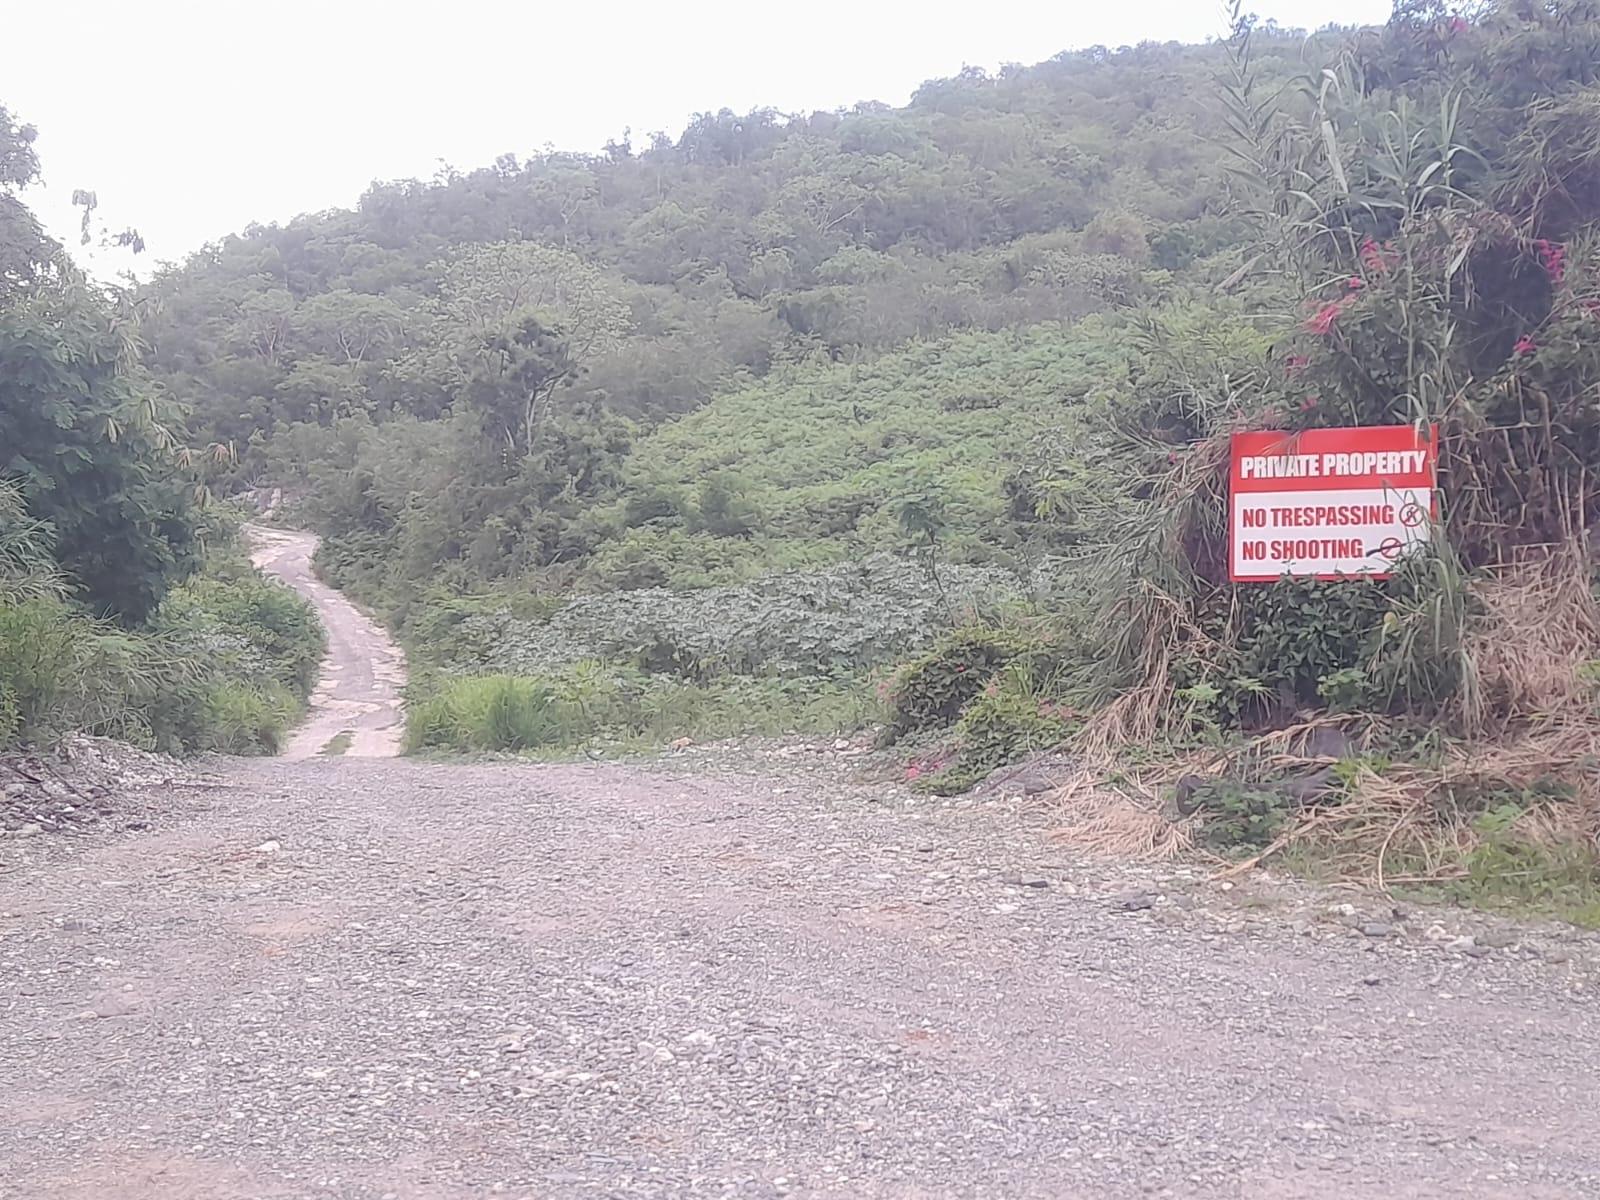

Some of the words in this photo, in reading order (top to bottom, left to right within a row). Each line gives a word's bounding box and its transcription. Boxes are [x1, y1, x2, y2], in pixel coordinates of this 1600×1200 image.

[1240, 453, 1319, 479] PRIVATE
[1322, 450, 1426, 476] PROPERTY
[1242, 508, 1266, 528] NO
[1270, 505, 1394, 527] TRESPASSING
[1242, 541, 1266, 560] NO
[1270, 538, 1363, 560] SHOOTING
